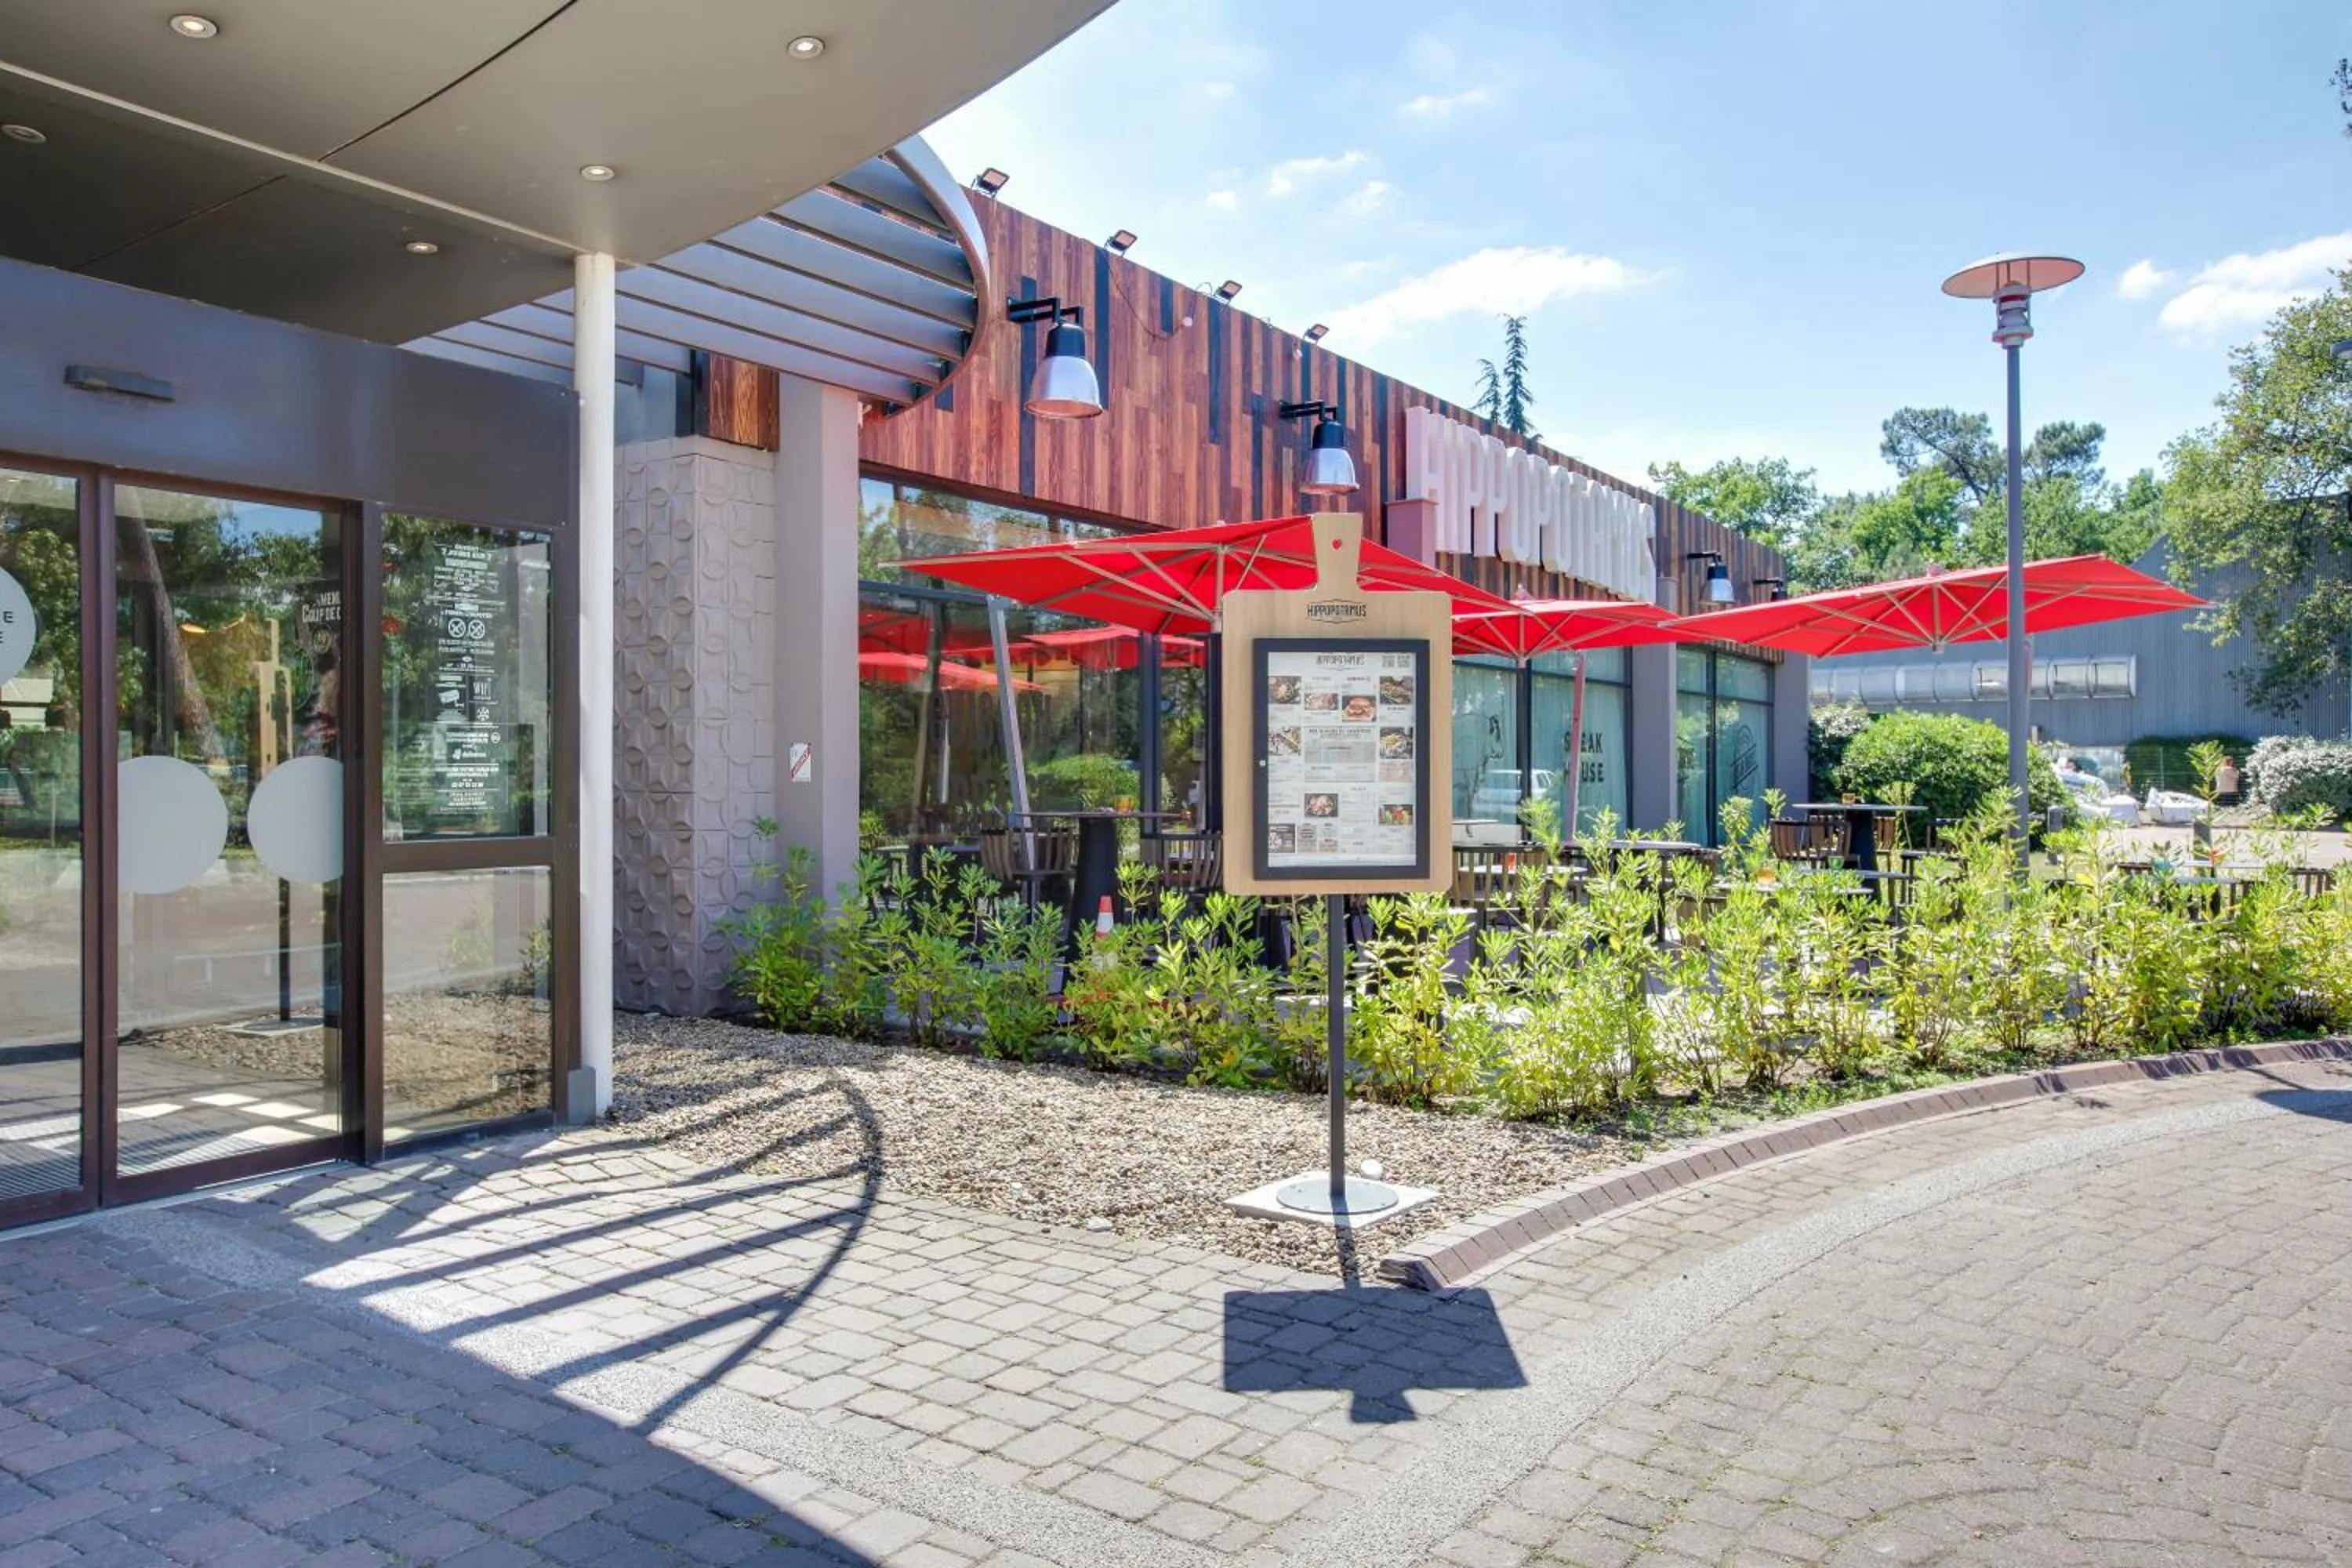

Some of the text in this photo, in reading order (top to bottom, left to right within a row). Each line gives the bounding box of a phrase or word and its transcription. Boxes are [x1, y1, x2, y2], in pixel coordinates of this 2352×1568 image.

[1307, 604, 1367, 617] HIPPOPOTAMUS
[1564, 731, 1602, 753] SEAK
[1563, 761, 1604, 782] HUSE
